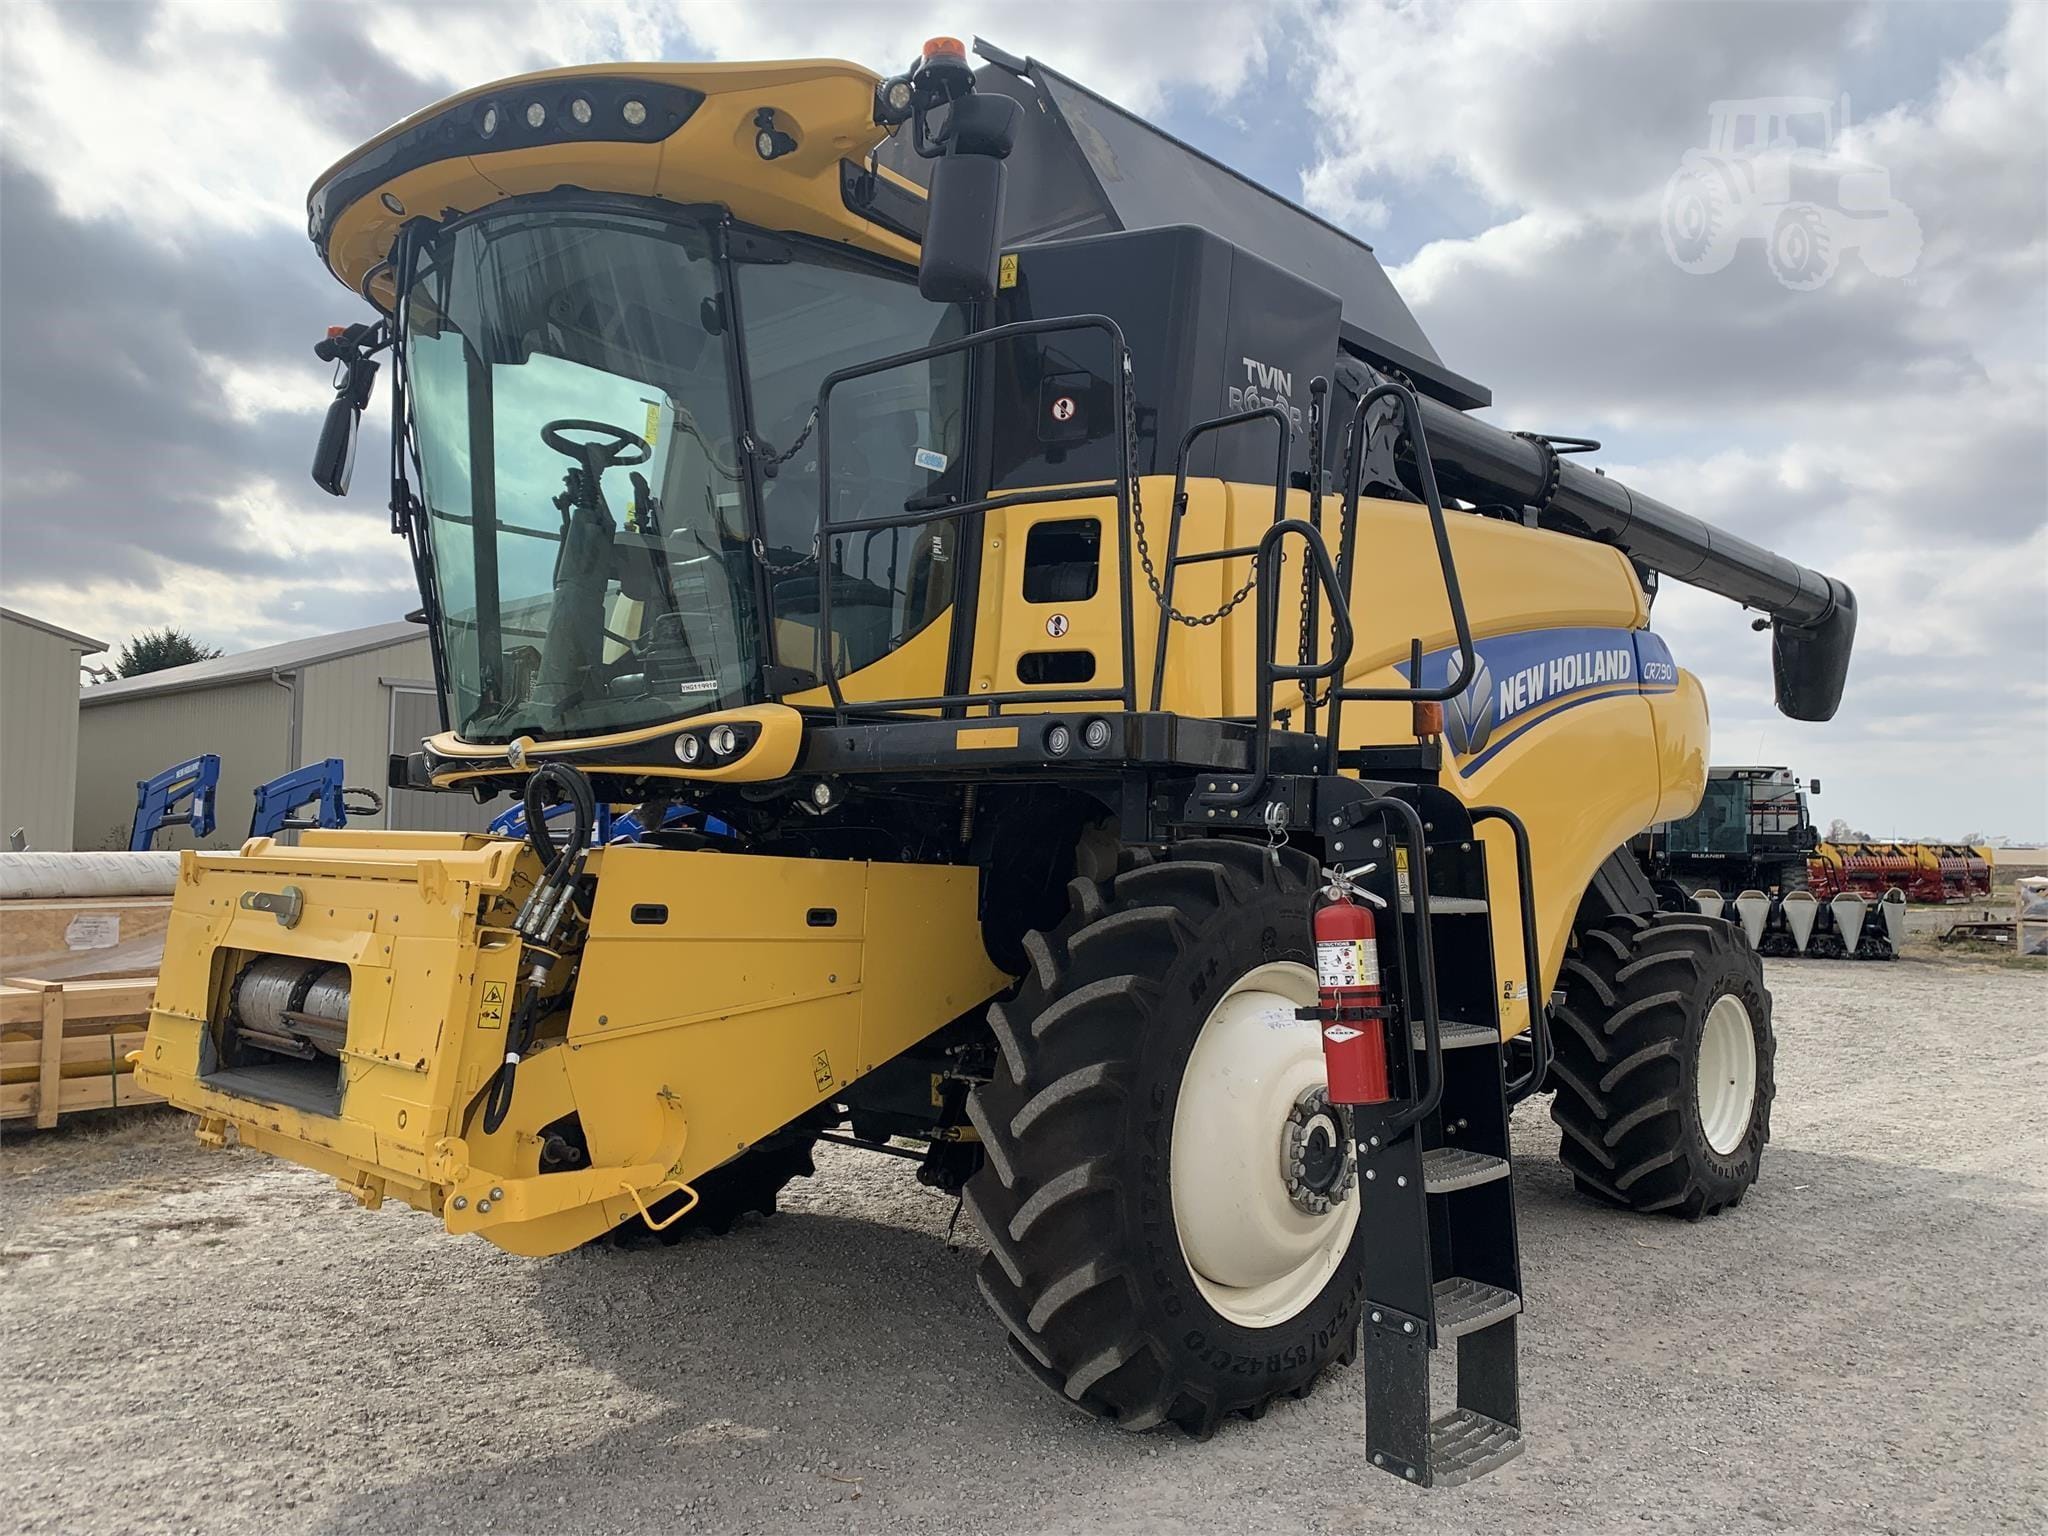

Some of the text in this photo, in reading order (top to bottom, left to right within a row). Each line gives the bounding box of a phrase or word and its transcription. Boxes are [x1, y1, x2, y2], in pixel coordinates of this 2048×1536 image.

[1242, 357, 1292, 397] TWIN
[1499, 649, 1631, 721] NEW HOLLAND
[1643, 662, 1672, 681] CR7.90
